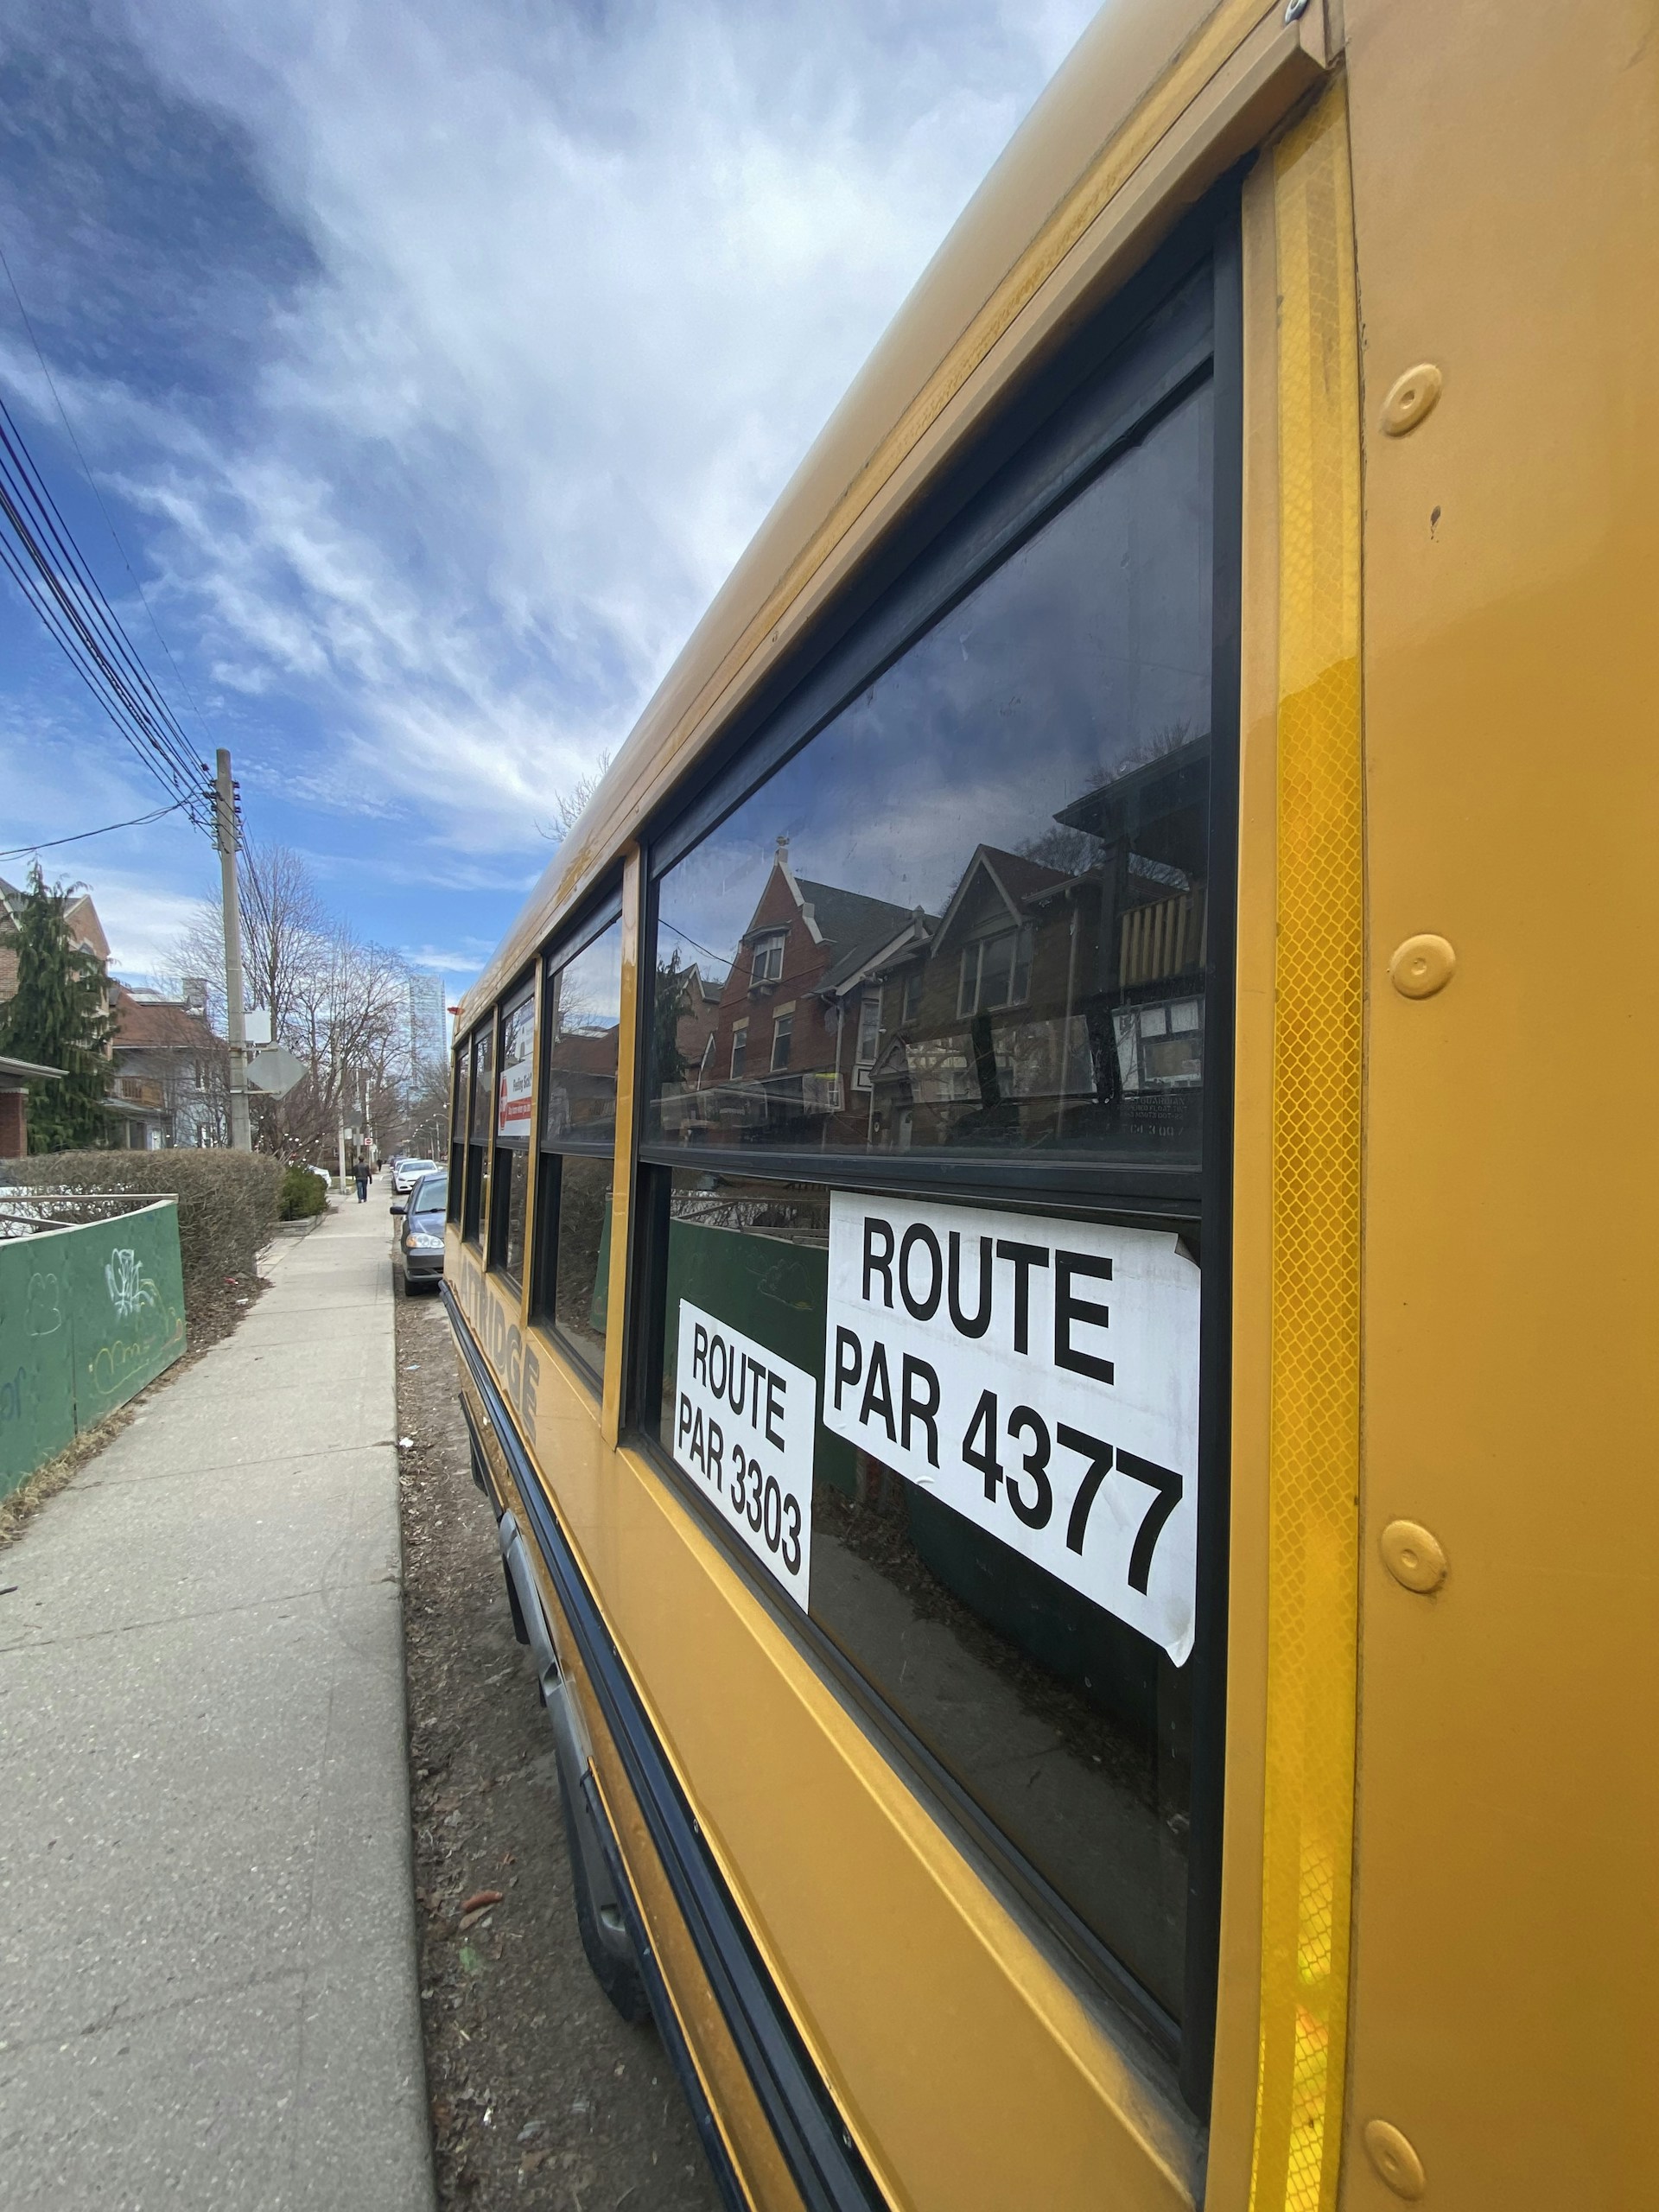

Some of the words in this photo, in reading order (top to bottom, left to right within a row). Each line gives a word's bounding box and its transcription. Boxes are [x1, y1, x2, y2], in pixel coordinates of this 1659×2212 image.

[694, 1323, 785, 1452] ROUTE
[863, 1217, 1114, 1386] ROUTE
[679, 1393, 724, 1492] PAR
[730, 1445, 802, 1576] 3303
[835, 1325, 940, 1469] PAR
[962, 1389, 1183, 1596] 4377
